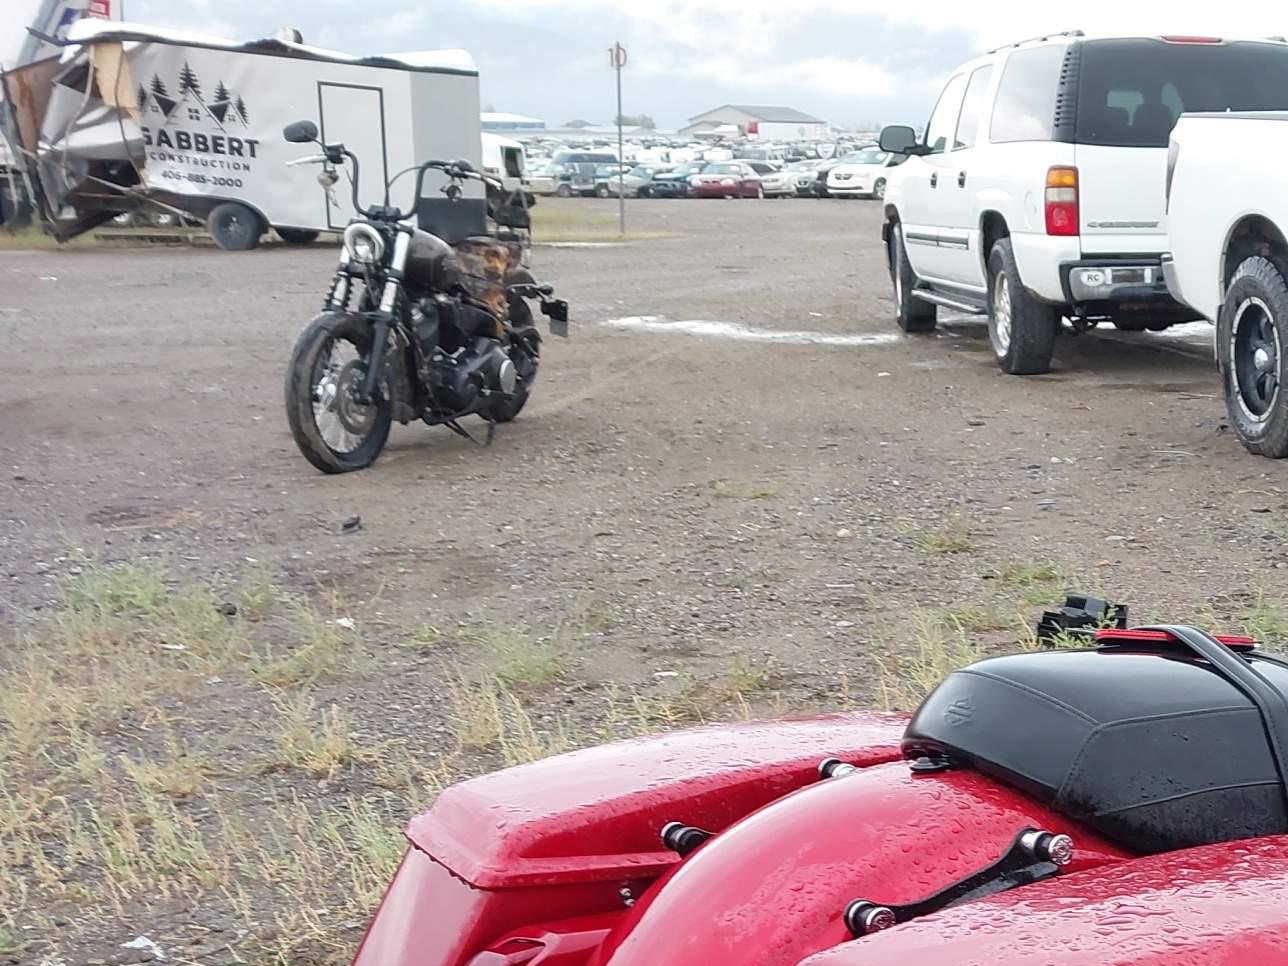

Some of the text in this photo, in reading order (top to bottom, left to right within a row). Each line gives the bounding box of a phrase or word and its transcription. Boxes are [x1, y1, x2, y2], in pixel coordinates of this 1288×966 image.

[607, 47, 628, 67] 10
[141, 126, 259, 158] GABBERT
[150, 151, 251, 171] CONSTRUCTION
